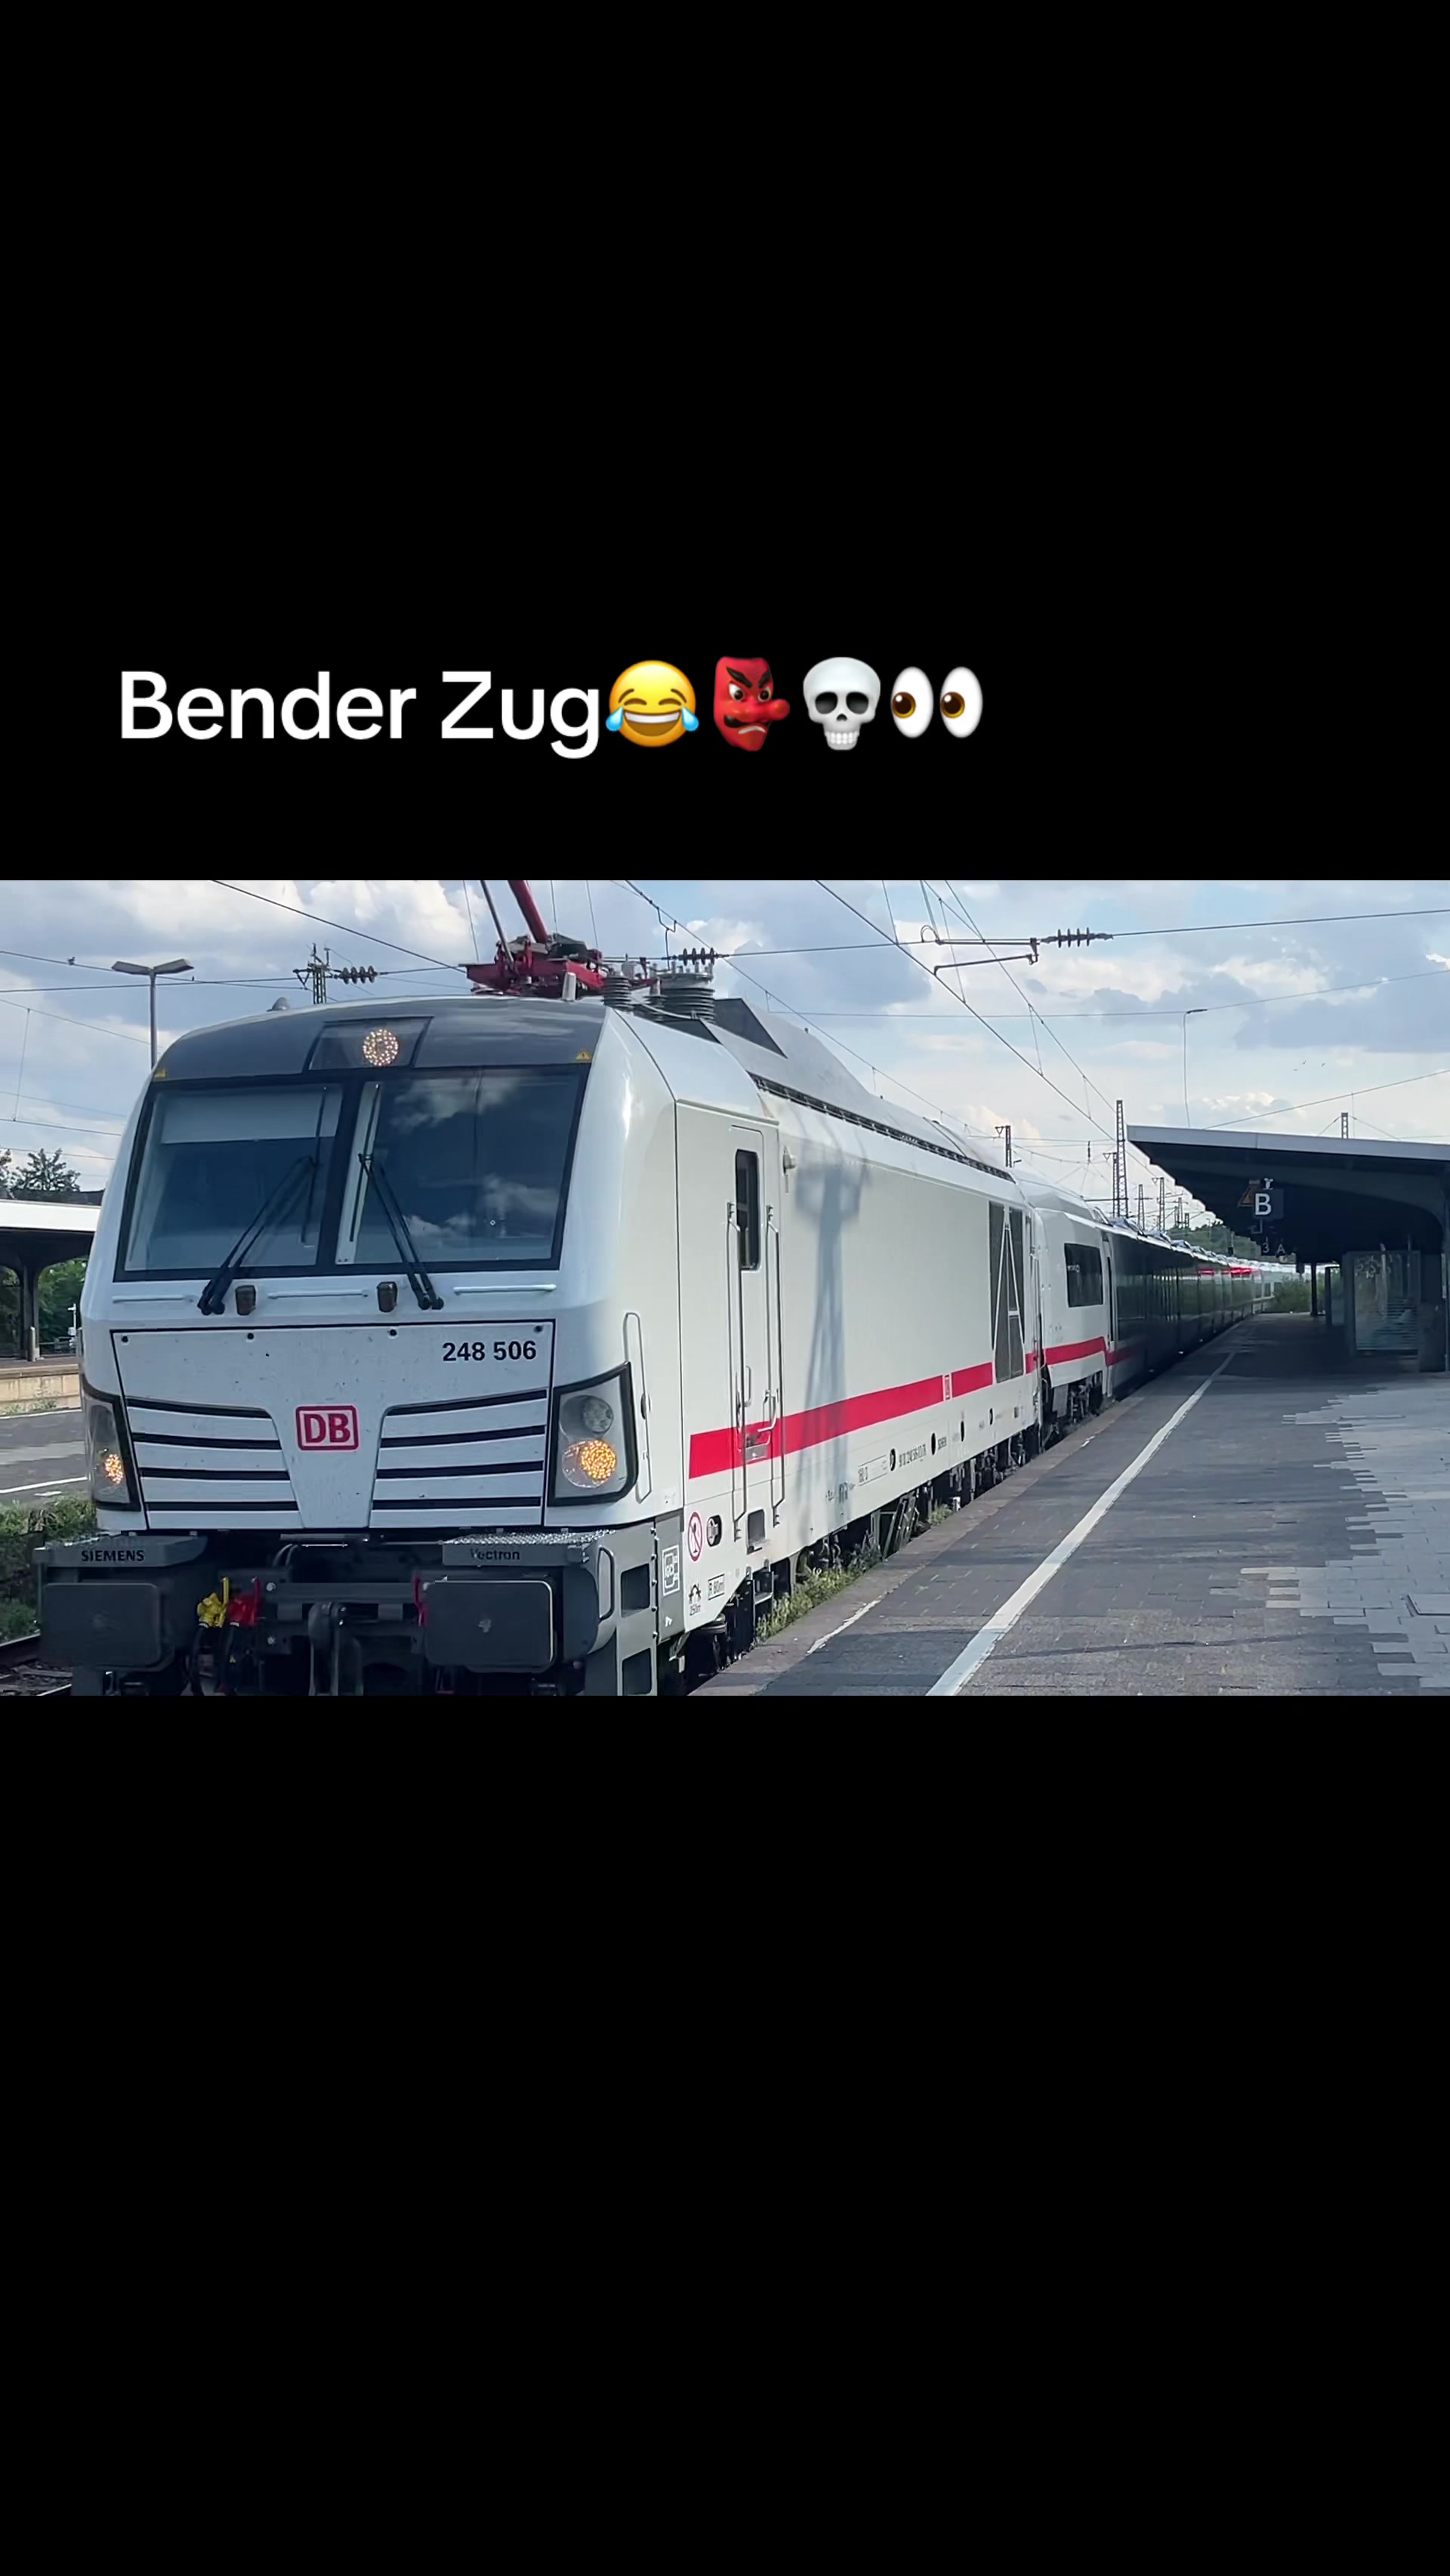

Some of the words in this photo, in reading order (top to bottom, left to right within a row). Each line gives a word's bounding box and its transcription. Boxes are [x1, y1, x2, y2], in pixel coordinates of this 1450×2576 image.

[1255, 1193, 1272, 1216] B
[443, 1342, 486, 1361] 248
[493, 1340, 537, 1360] 506
[304, 1413, 351, 1444] DB
[81, 1549, 145, 1562] SIEMENS
[469, 1548, 520, 1561] Vectron
